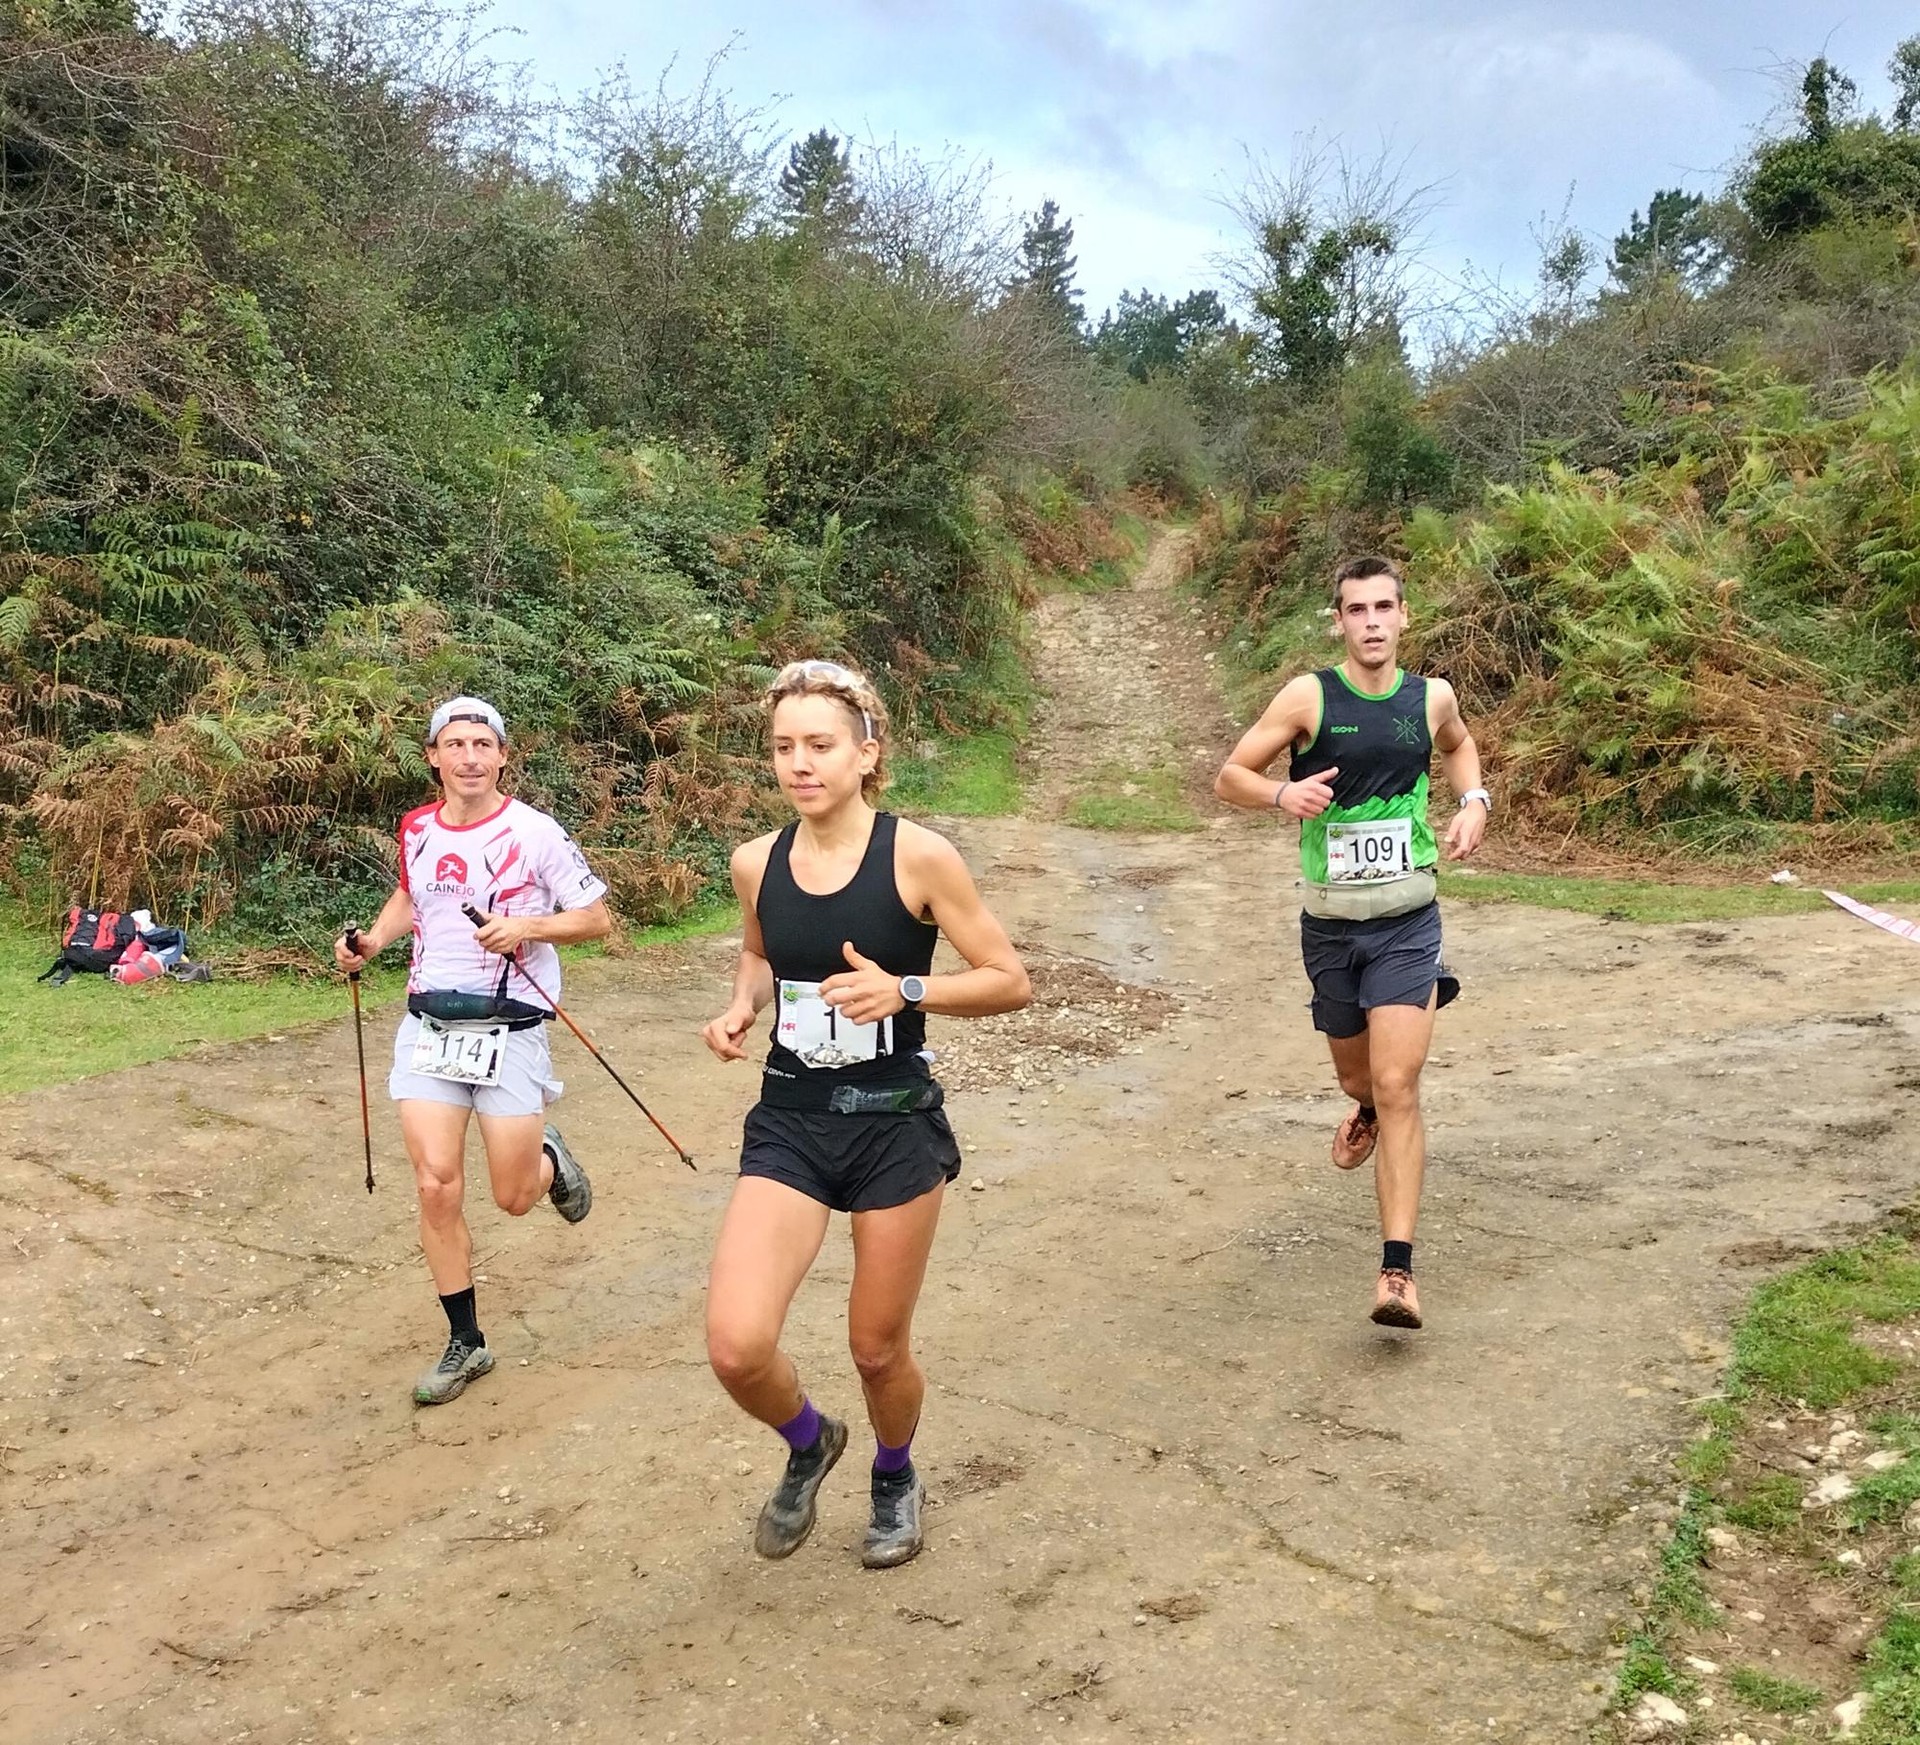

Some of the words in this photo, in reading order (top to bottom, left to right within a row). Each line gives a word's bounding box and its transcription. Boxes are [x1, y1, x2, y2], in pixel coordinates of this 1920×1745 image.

[1349, 836, 1393, 863] 109
[426, 882, 475, 896] CAINEJO
[440, 1034, 483, 1062] 114
